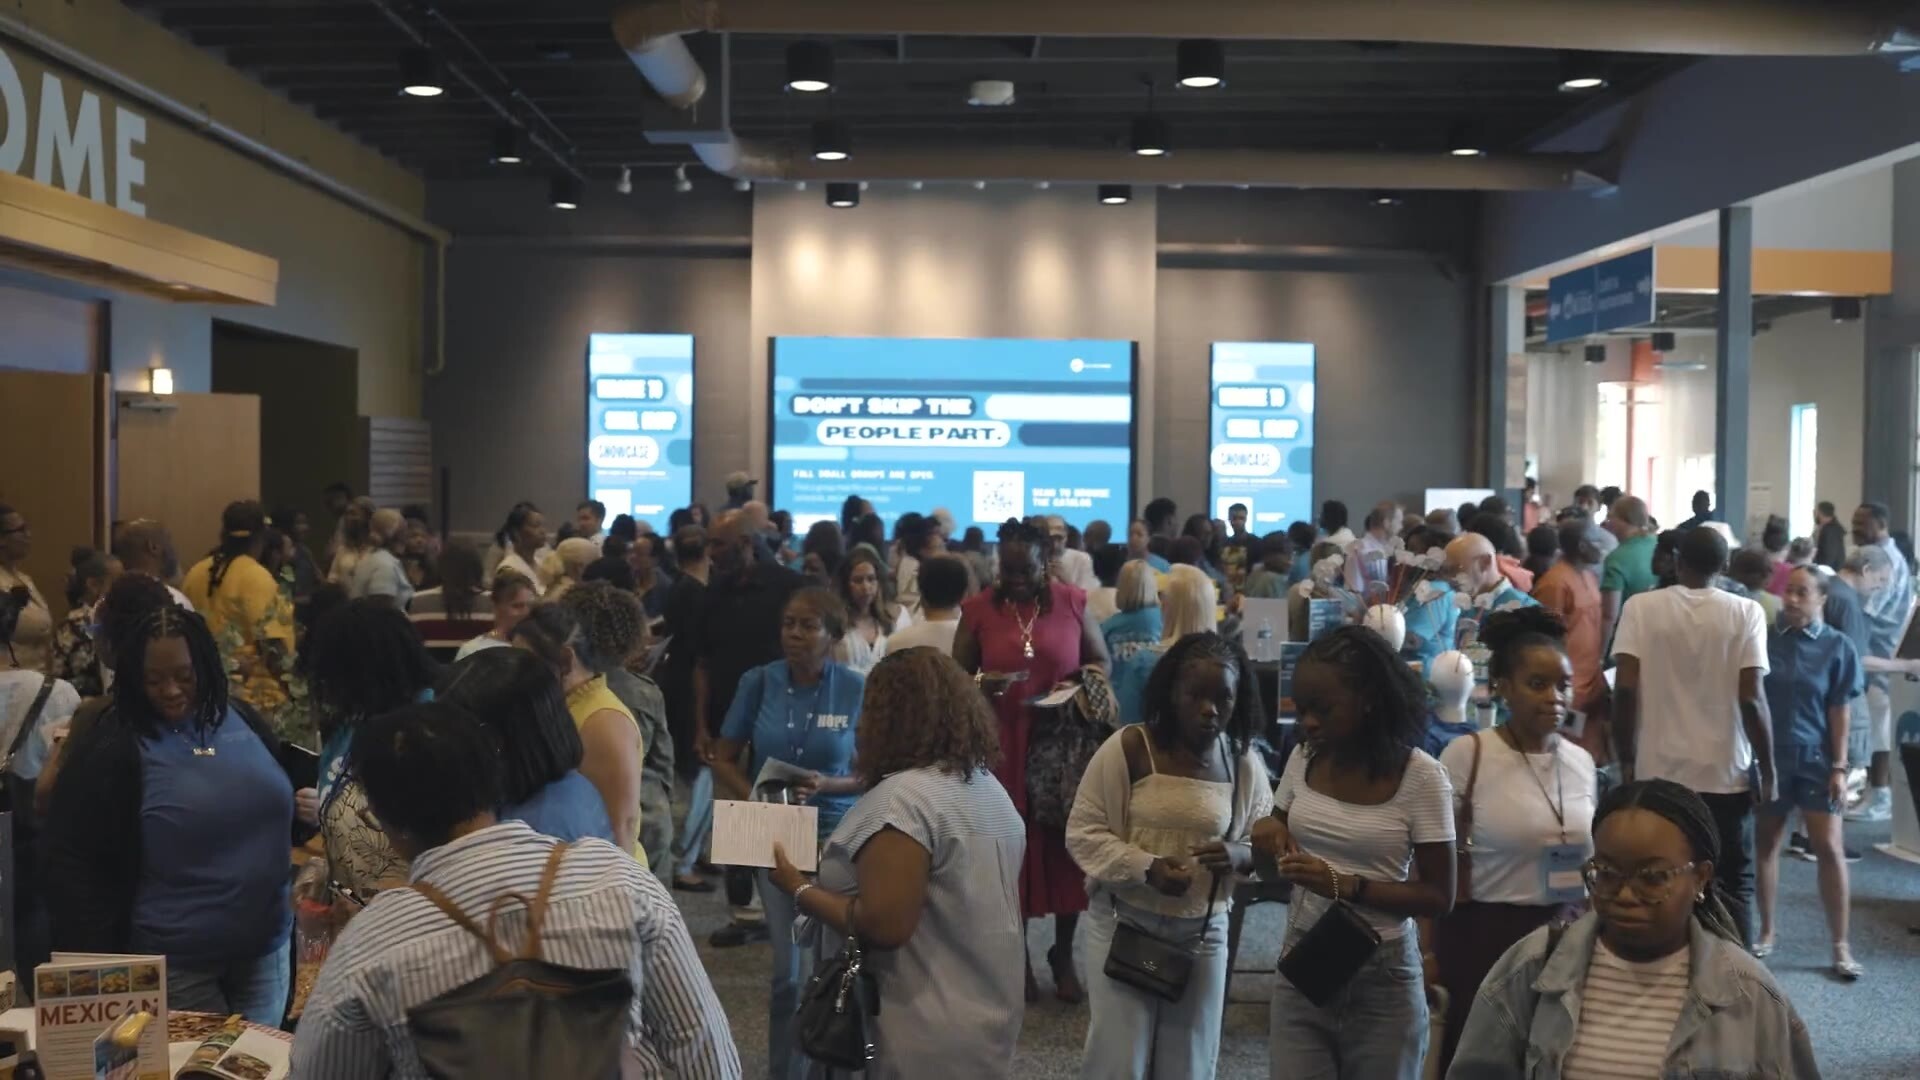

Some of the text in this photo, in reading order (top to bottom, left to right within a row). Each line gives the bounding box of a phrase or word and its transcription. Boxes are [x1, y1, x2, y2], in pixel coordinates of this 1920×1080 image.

[793, 396, 972, 416] DON'T SKIP THE
[825, 426, 1003, 441] PEOPLE PART.
[816, 714, 849, 728] HOPE
